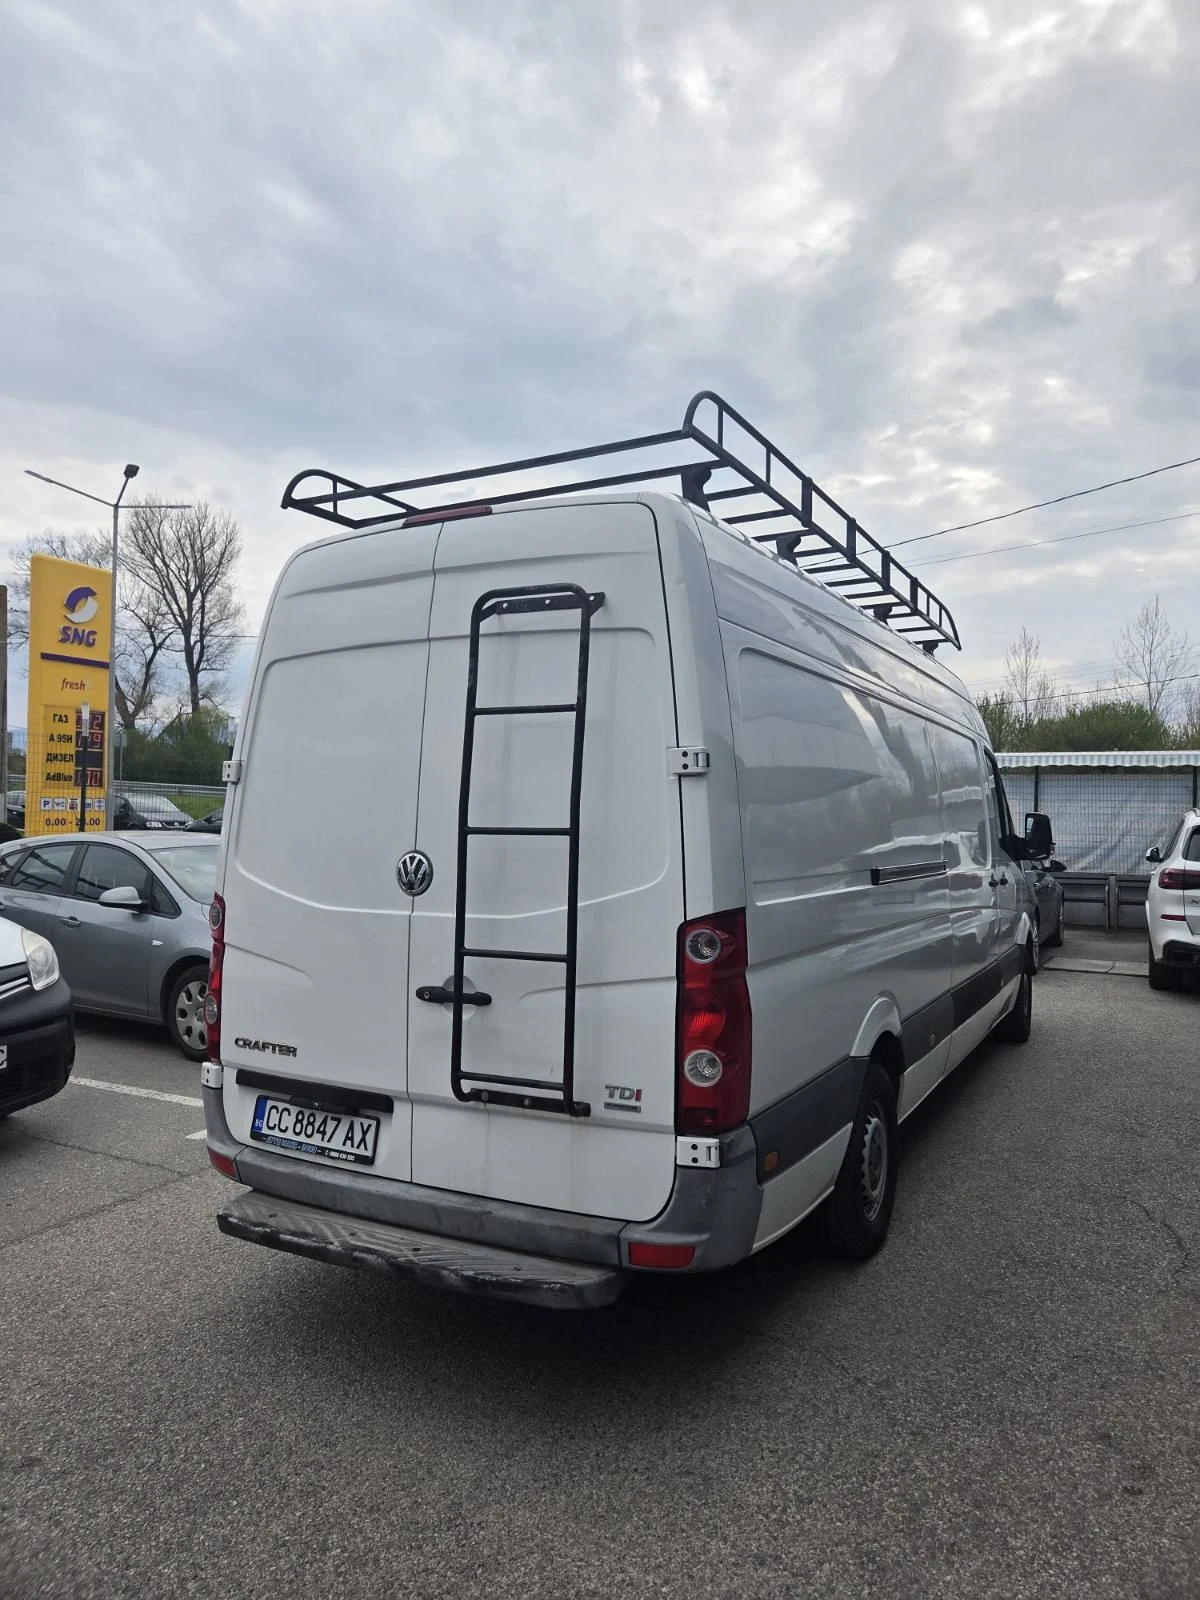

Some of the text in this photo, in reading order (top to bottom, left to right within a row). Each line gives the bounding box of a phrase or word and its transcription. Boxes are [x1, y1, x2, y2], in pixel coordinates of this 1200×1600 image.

[58, 625, 97, 647] SNG
[60, 677, 86, 691] fresh
[53, 713, 69, 724] ГАЗ
[46, 752, 74, 764] ДИЗЕЛ
[46, 772, 73, 782] AdBlue
[43, 799, 50, 808] P
[45, 817, 66, 826] 0.00
[74, 817, 101, 826] 2.00
[234, 1037, 298, 1057] CRAFTER
[605, 1085, 642, 1102] TDI
[255, 1119, 264, 1128] BG
[342, 1120, 372, 1151] AX
